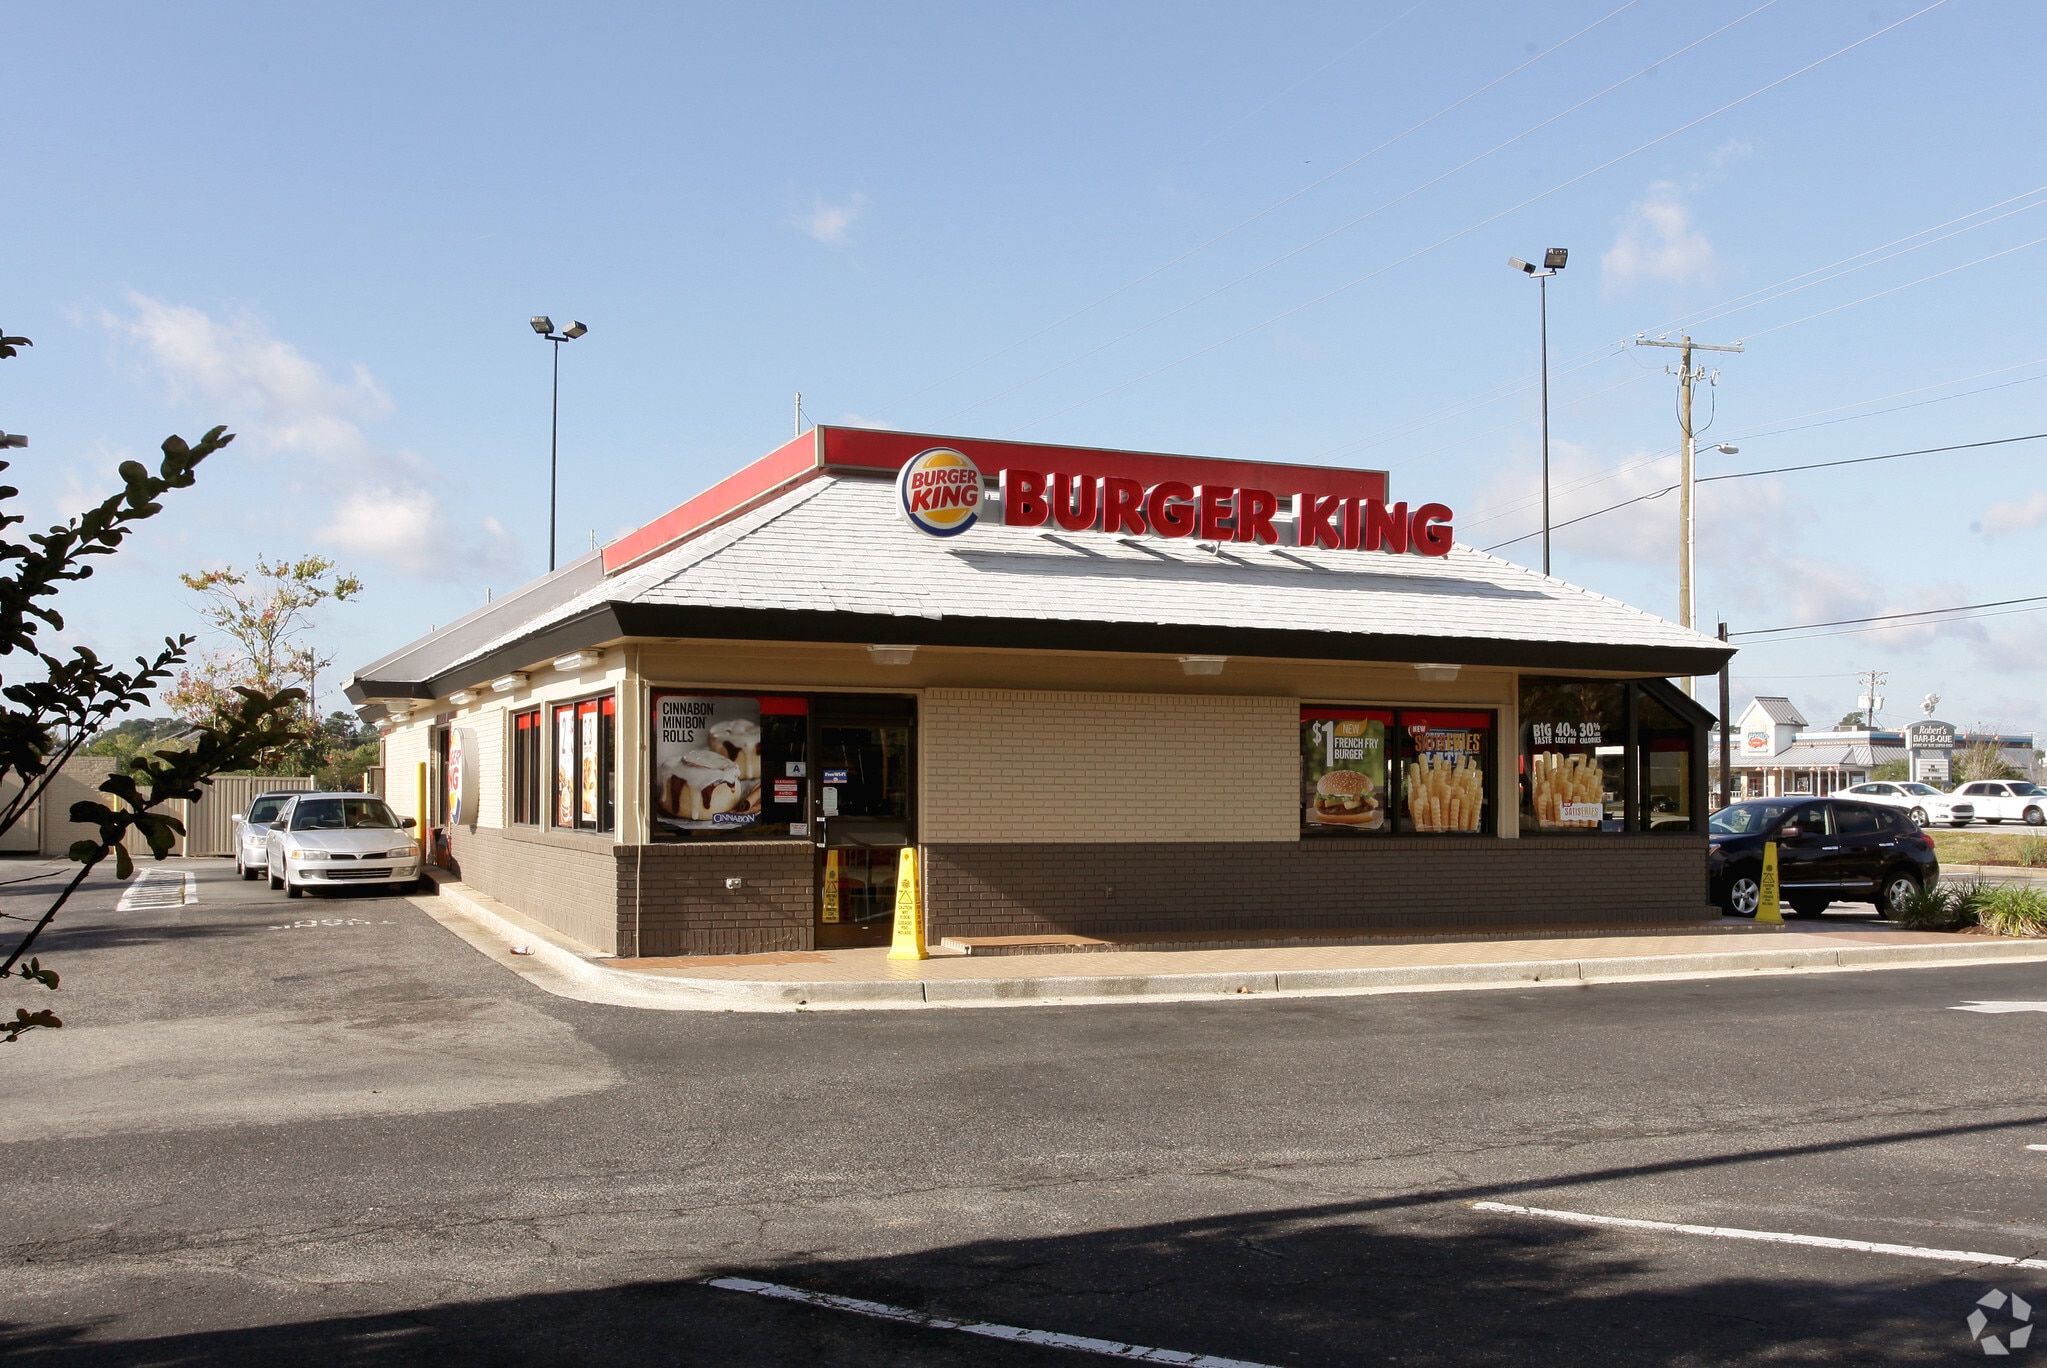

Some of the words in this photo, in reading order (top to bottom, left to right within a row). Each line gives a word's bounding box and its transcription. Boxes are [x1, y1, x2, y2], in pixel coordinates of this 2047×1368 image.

[912, 469, 977, 490] BURGER
[911, 485, 979, 512] KING
[1000, 468, 1279, 545] BURGER
[1293, 492, 1454, 557] KING
[662, 702, 714, 715] CINNABON
[662, 716, 706, 729] MINIBON
[1342, 723, 1360, 734] NEW
[1533, 723, 1552, 737] BIG
[1555, 722, 1577, 737] 40%
[1579, 722, 1601, 737] 30%
[1919, 725, 1947, 735] Robert's
[662, 730, 694, 743] ROLLS
[1534, 736, 1552, 745] TASTE
[1913, 735, 1953, 743] BAR-B-QUE
[1312, 720, 1334, 767] $1
[1334, 738, 1364, 749] FRENCH
[1365, 738, 1379, 749] FRY
[1334, 749, 1363, 760] BURGER
[713, 814, 754, 822] CINNABON
